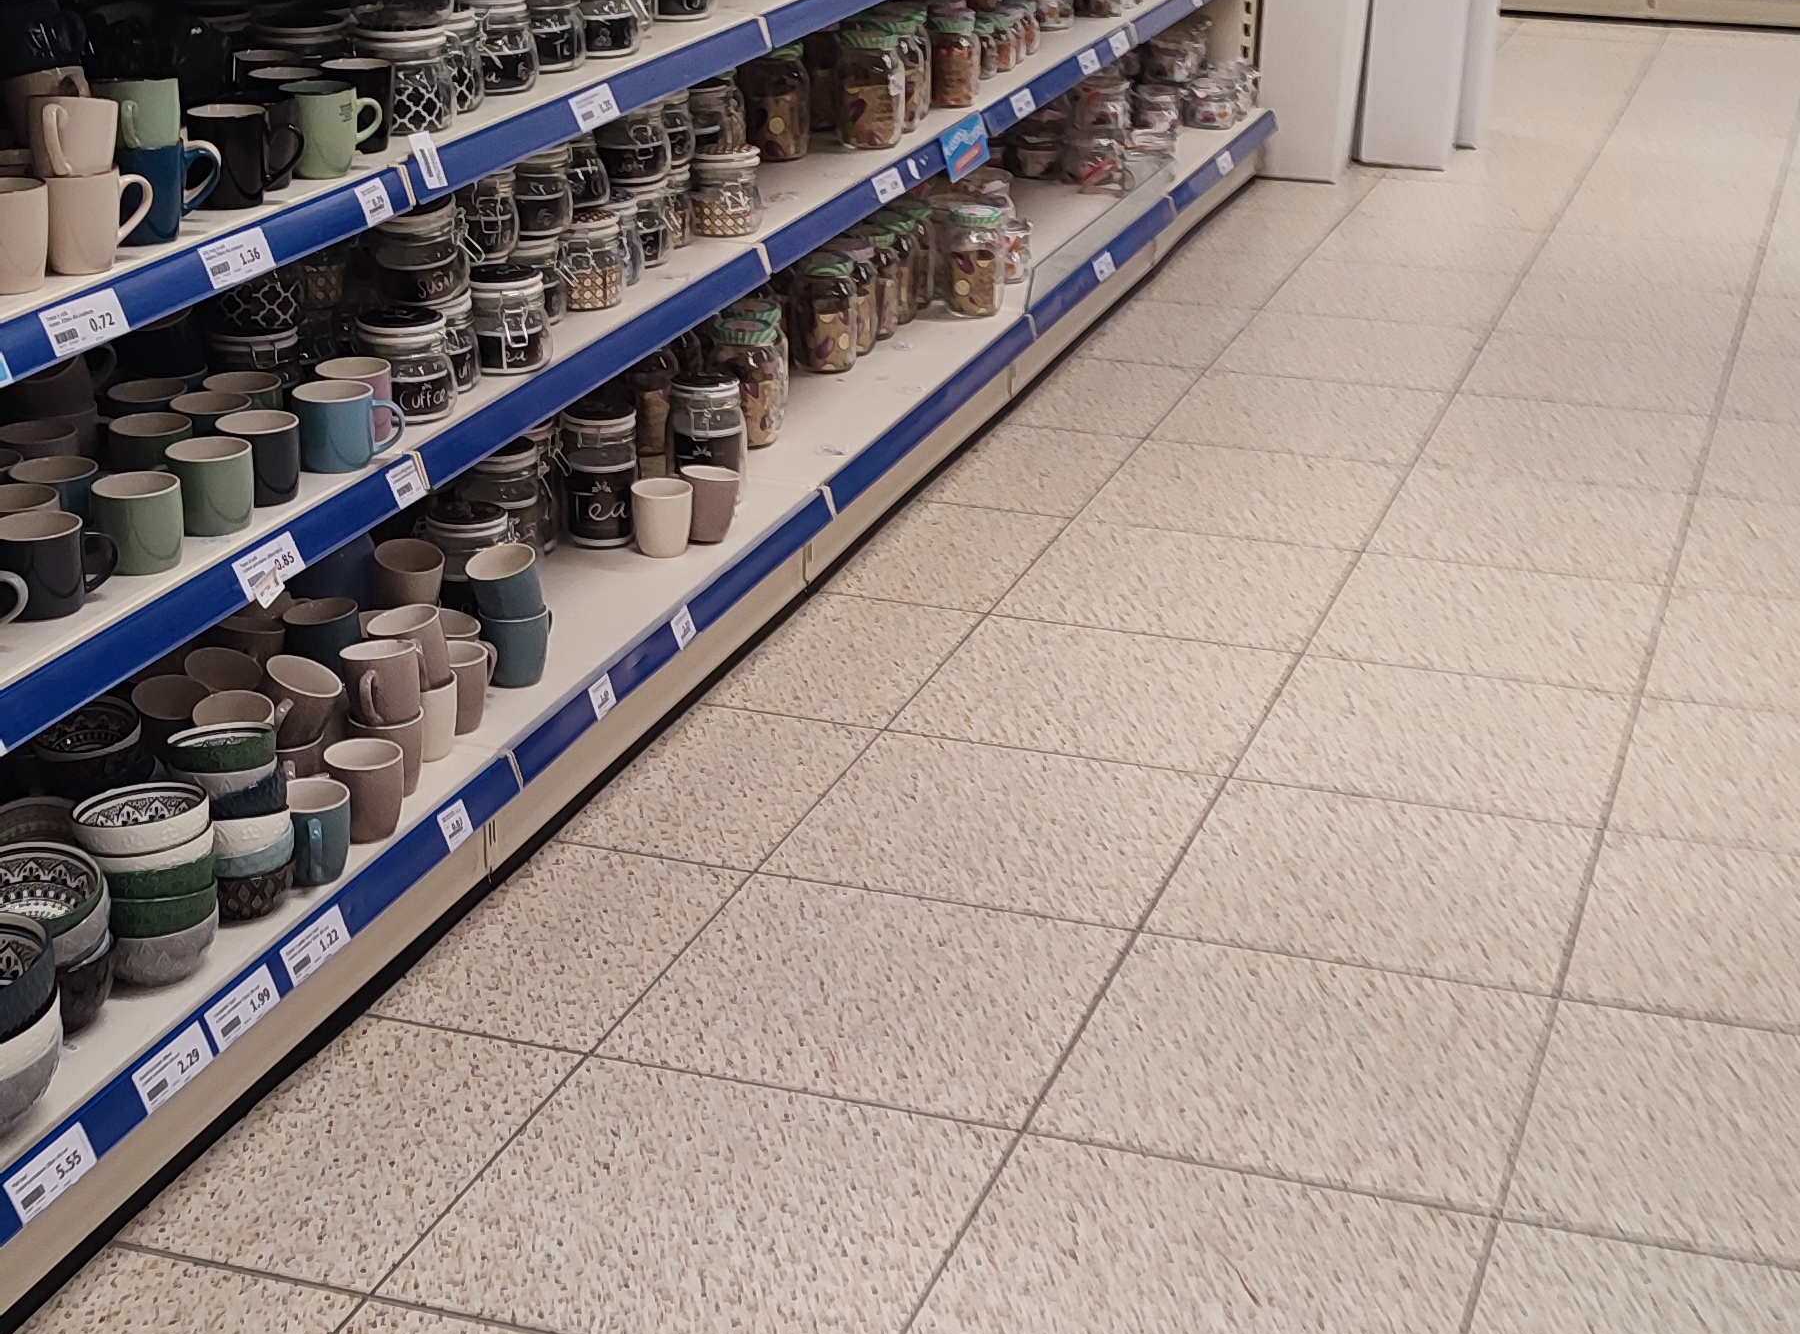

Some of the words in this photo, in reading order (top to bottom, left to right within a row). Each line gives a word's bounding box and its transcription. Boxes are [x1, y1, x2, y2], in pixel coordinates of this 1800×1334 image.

[239, 246, 261, 266] 1.36
[89, 312, 117, 333] 0.72
[572, 491, 628, 521] Tea
[274, 551, 295, 571] 0.85
[318, 928, 340, 954] 1.22
[249, 987, 271, 1013] 1.99
[176, 1048, 200, 1075] 2.29
[55, 1148, 82, 1180] 5.55
